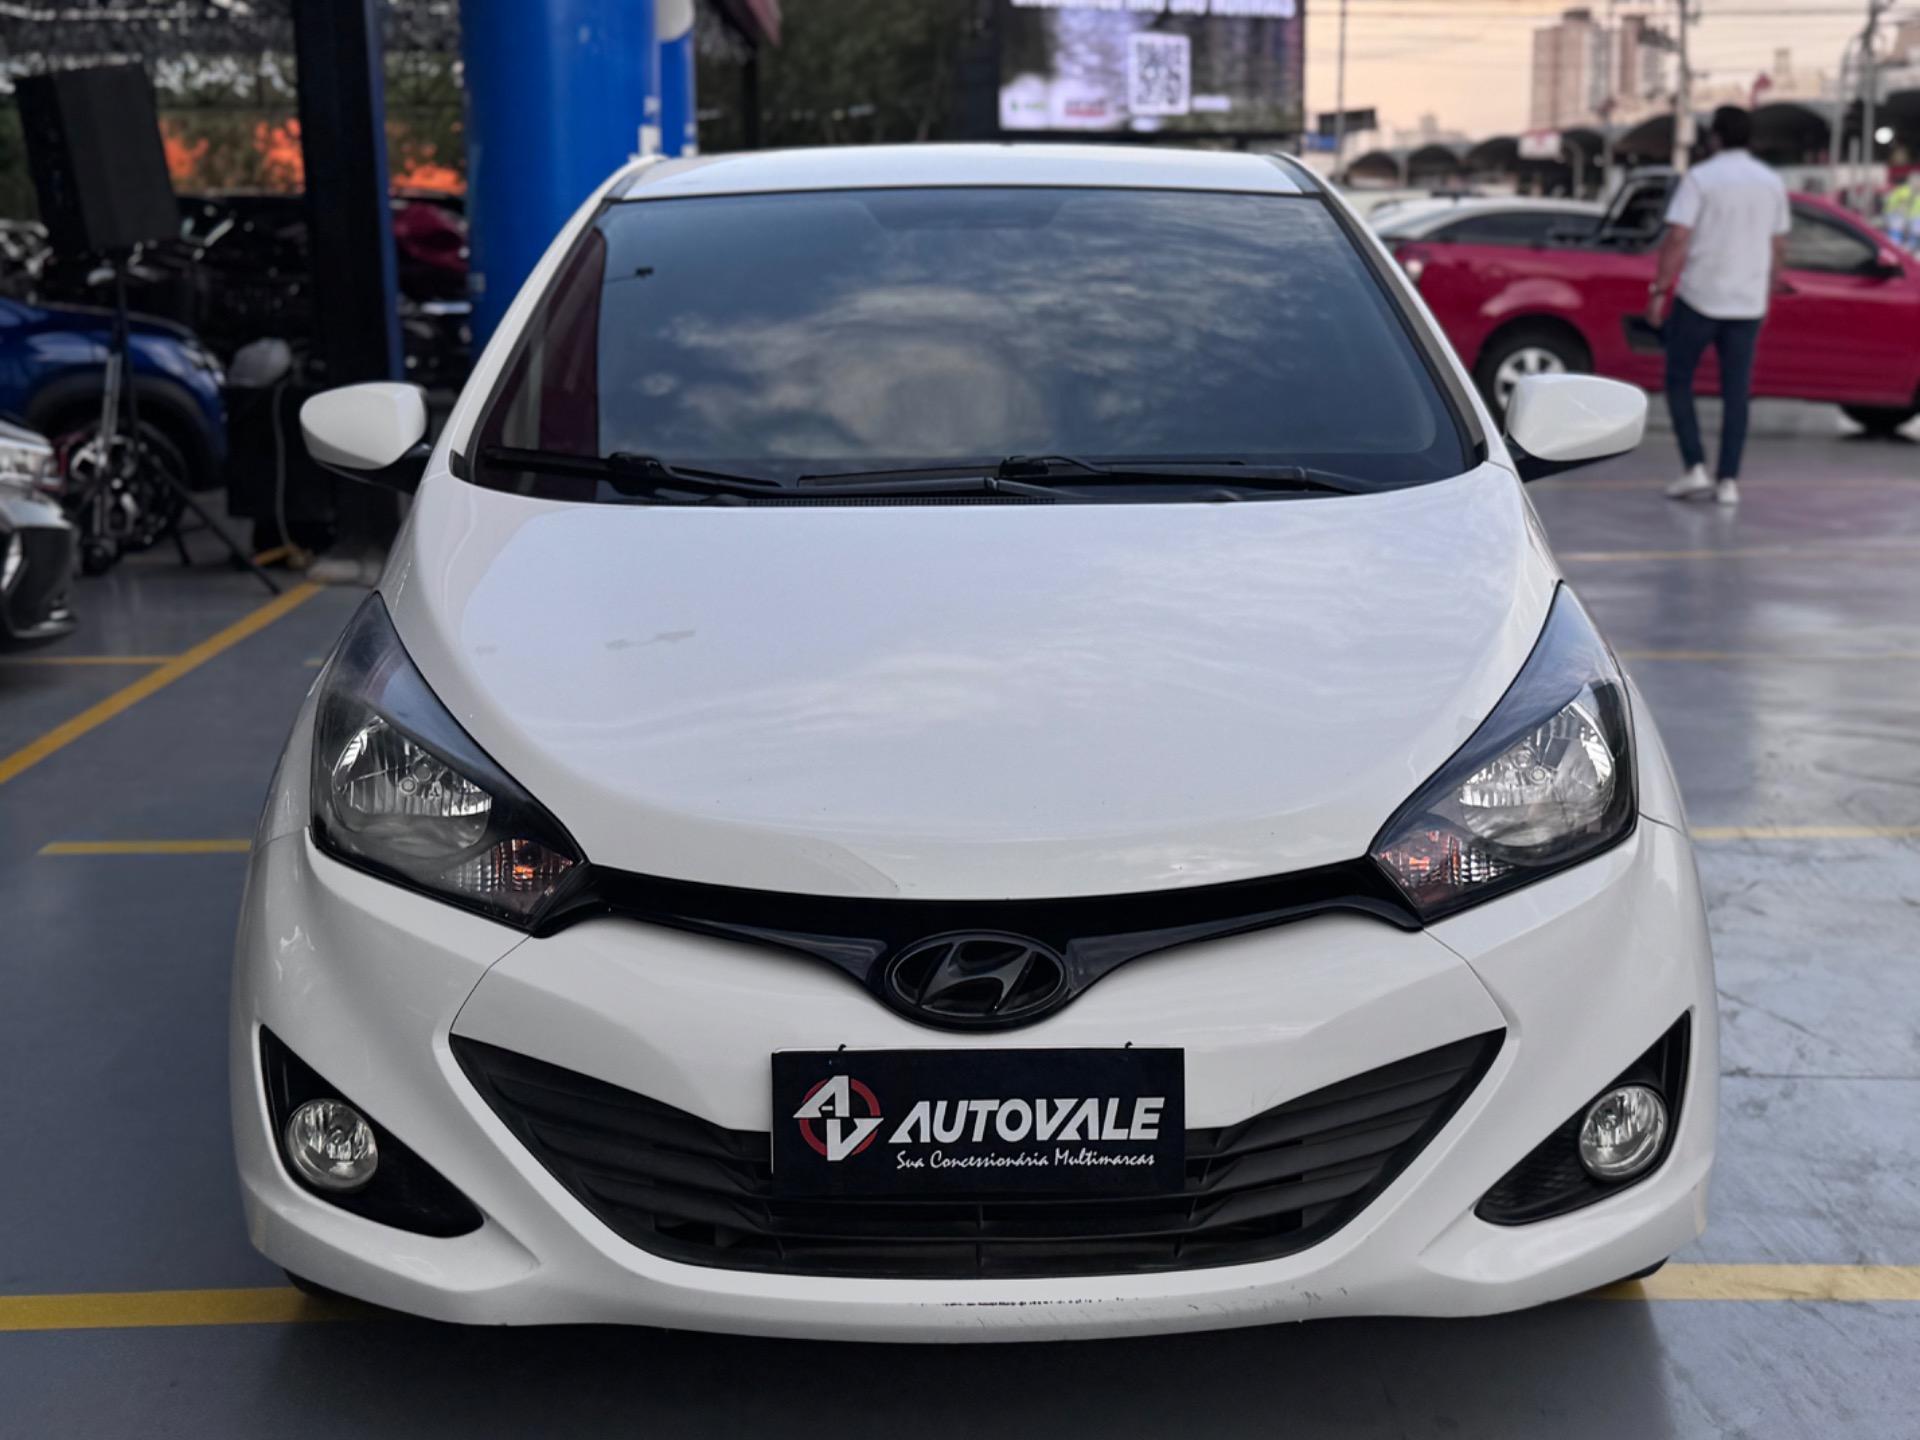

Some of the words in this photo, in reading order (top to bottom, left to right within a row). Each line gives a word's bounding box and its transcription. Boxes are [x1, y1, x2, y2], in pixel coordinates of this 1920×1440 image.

[888, 1097, 1165, 1144] AUTOVALE
[896, 1150, 925, 1170] Sua
[929, 1150, 1049, 1170] Concessionária
[1054, 1147, 1156, 1168] Multimarcas
